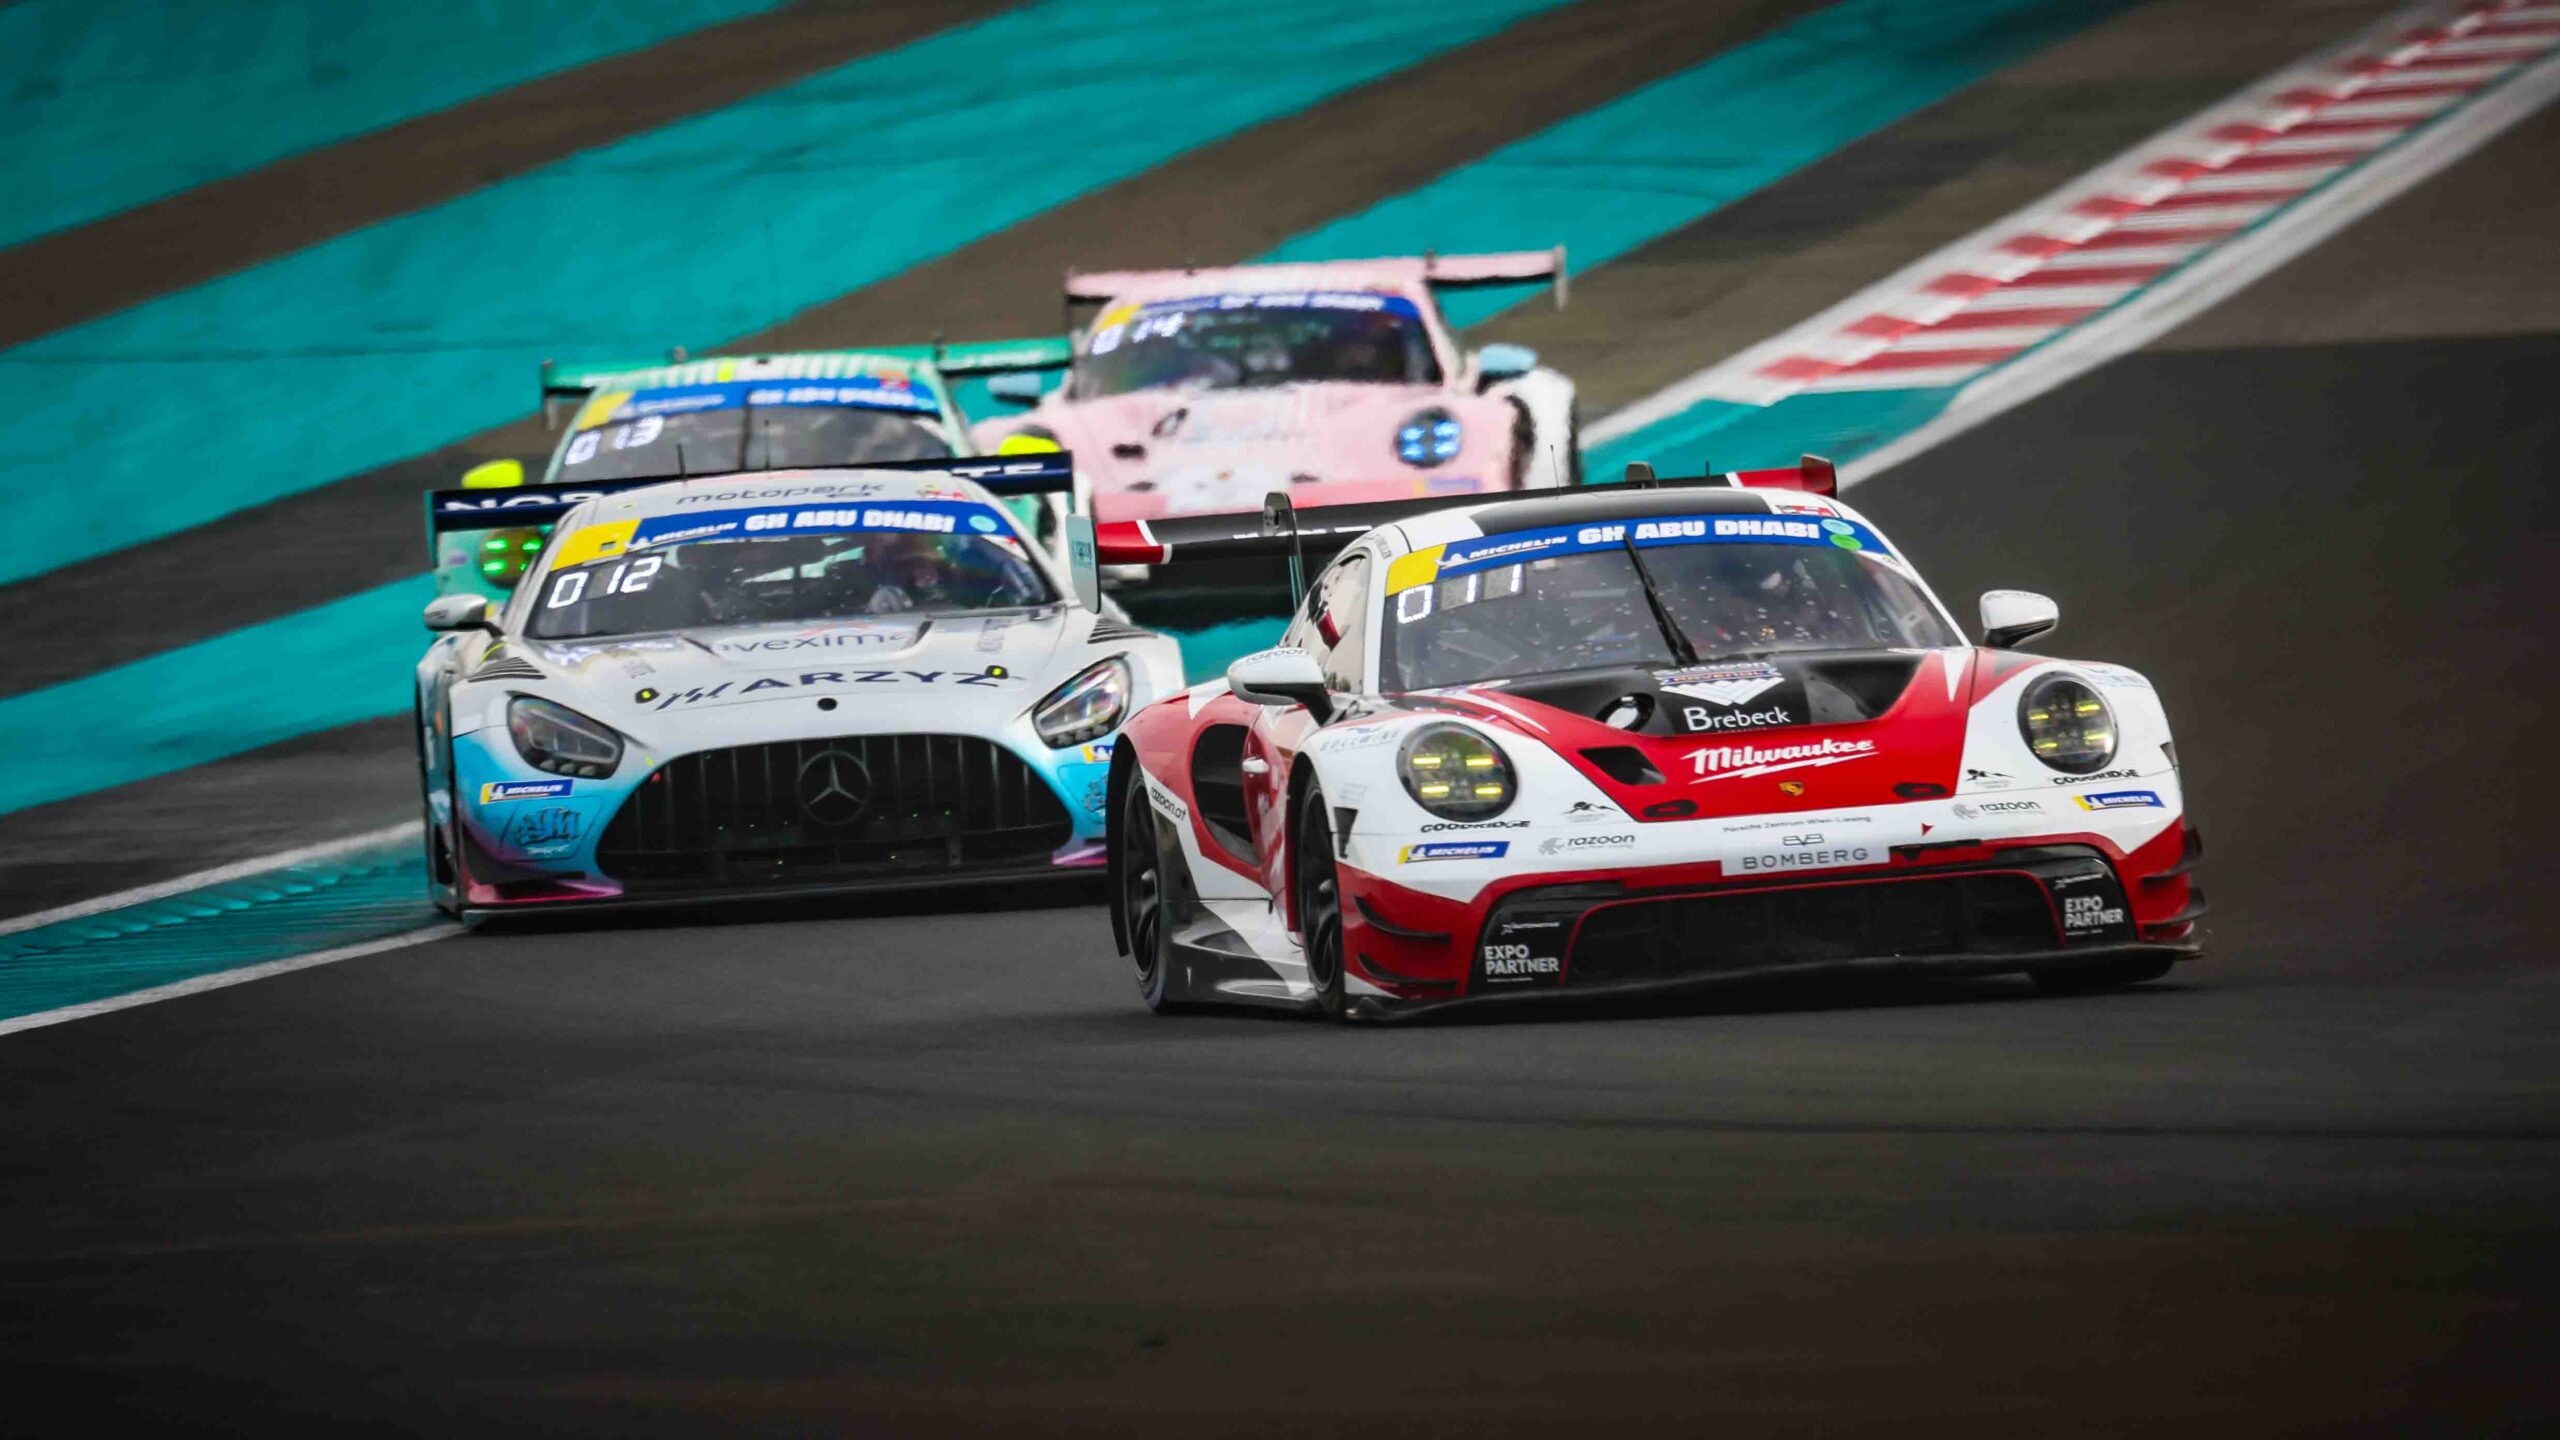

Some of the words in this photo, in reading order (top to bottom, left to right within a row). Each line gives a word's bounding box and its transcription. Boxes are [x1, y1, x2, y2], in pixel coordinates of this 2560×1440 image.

[676, 483, 884, 506] motopark
[792, 508, 858, 529] ABU
[861, 508, 956, 533] DHABI
[1469, 535, 1568, 560] MICHELIN
[1577, 524, 1626, 546] 6H
[1634, 519, 1706, 541] ABU
[1713, 518, 1821, 539] DHABI
[547, 556, 662, 609] 012
[1682, 705, 1793, 732] Brebeck
[1679, 738, 1875, 775] Milwaukee
[1979, 800, 2043, 812] razoon
[1566, 834, 1636, 848] razoon
[1743, 847, 1869, 870] BOMBERG
[2064, 895, 2103, 912] EXPO
[2065, 908, 2124, 928] PARTNER
[1484, 944, 1530, 960] EXPO
[1485, 957, 1559, 976] PARTNER
